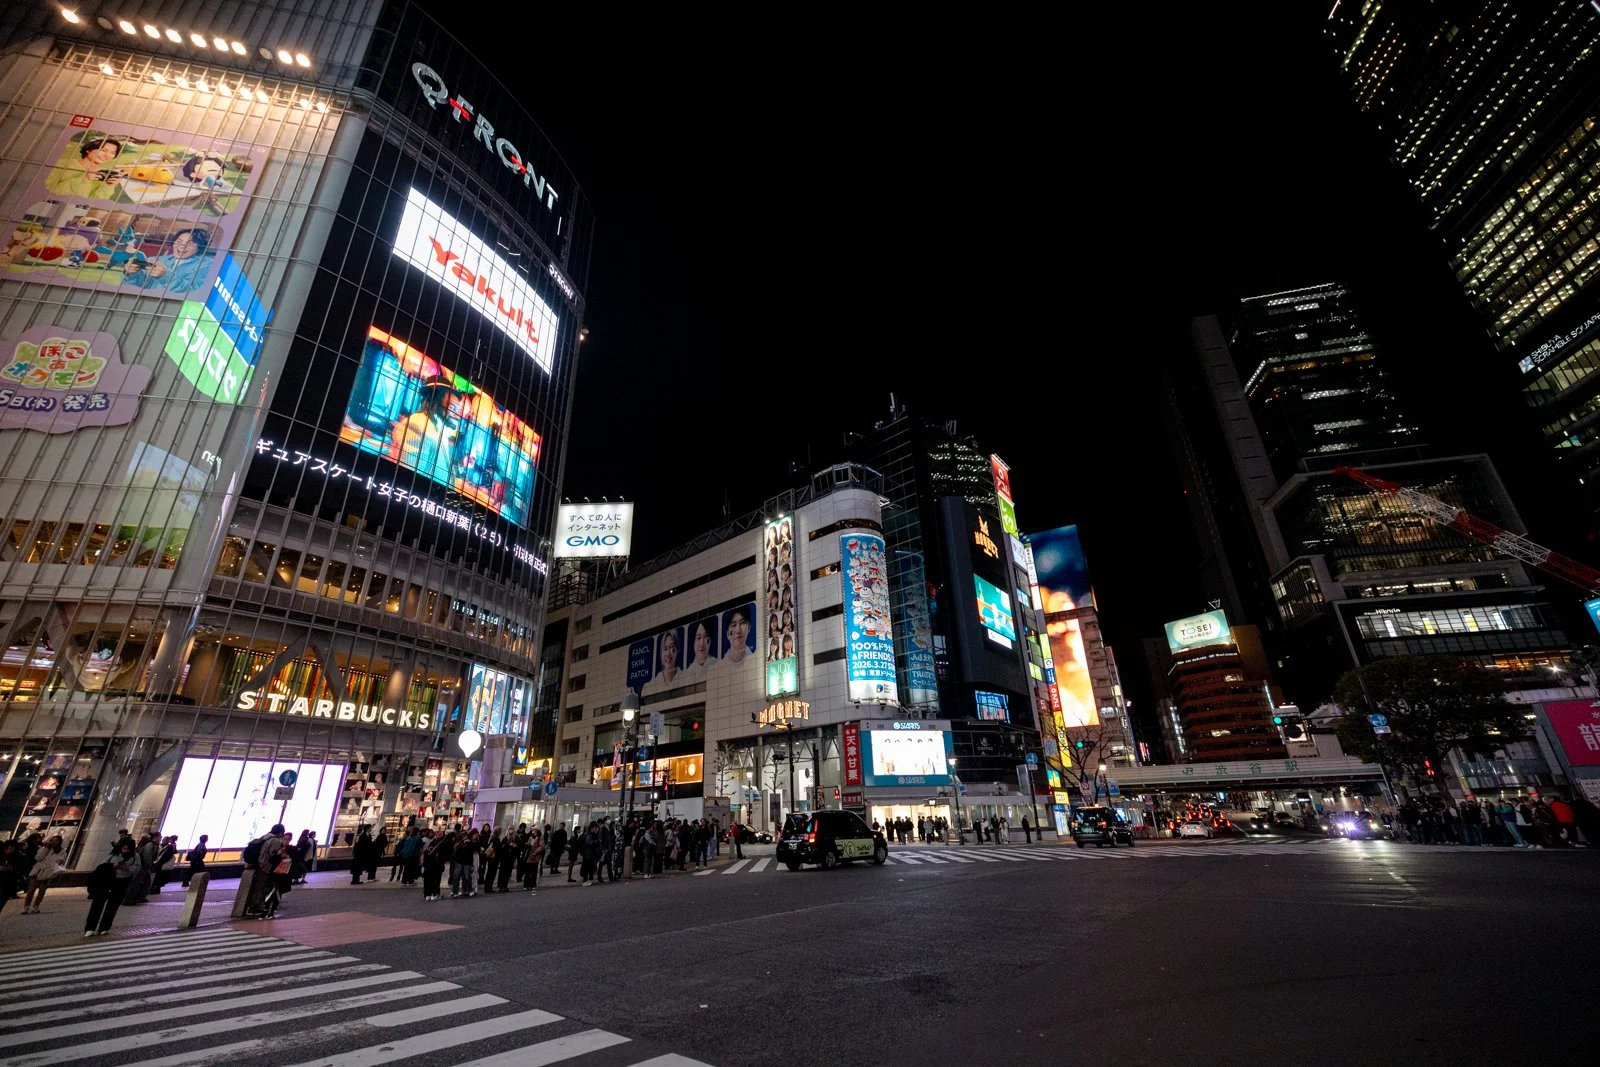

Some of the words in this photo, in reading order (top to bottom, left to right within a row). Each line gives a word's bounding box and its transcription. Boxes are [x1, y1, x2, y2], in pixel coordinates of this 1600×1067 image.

[429, 235, 540, 343] Yakult
[1531, 334, 1561, 359] SHIBUYA
[1534, 334, 1572, 364] SCRAMBLE
[63, 393, 106, 410] 発売
[569, 513, 622, 522] すべての人に
[568, 523, 621, 532] インターネット
[566, 535, 620, 547] GMO
[632, 645, 651, 656] FANCL
[631, 659, 646, 669] SKIN
[630, 669, 649, 680] PATCH
[237, 691, 430, 729] STARBUCKS
[759, 700, 810, 728] MAGNET
[846, 735, 858, 781] 天津甘栗
[1215, 760, 1300, 775] 渋谷駅
